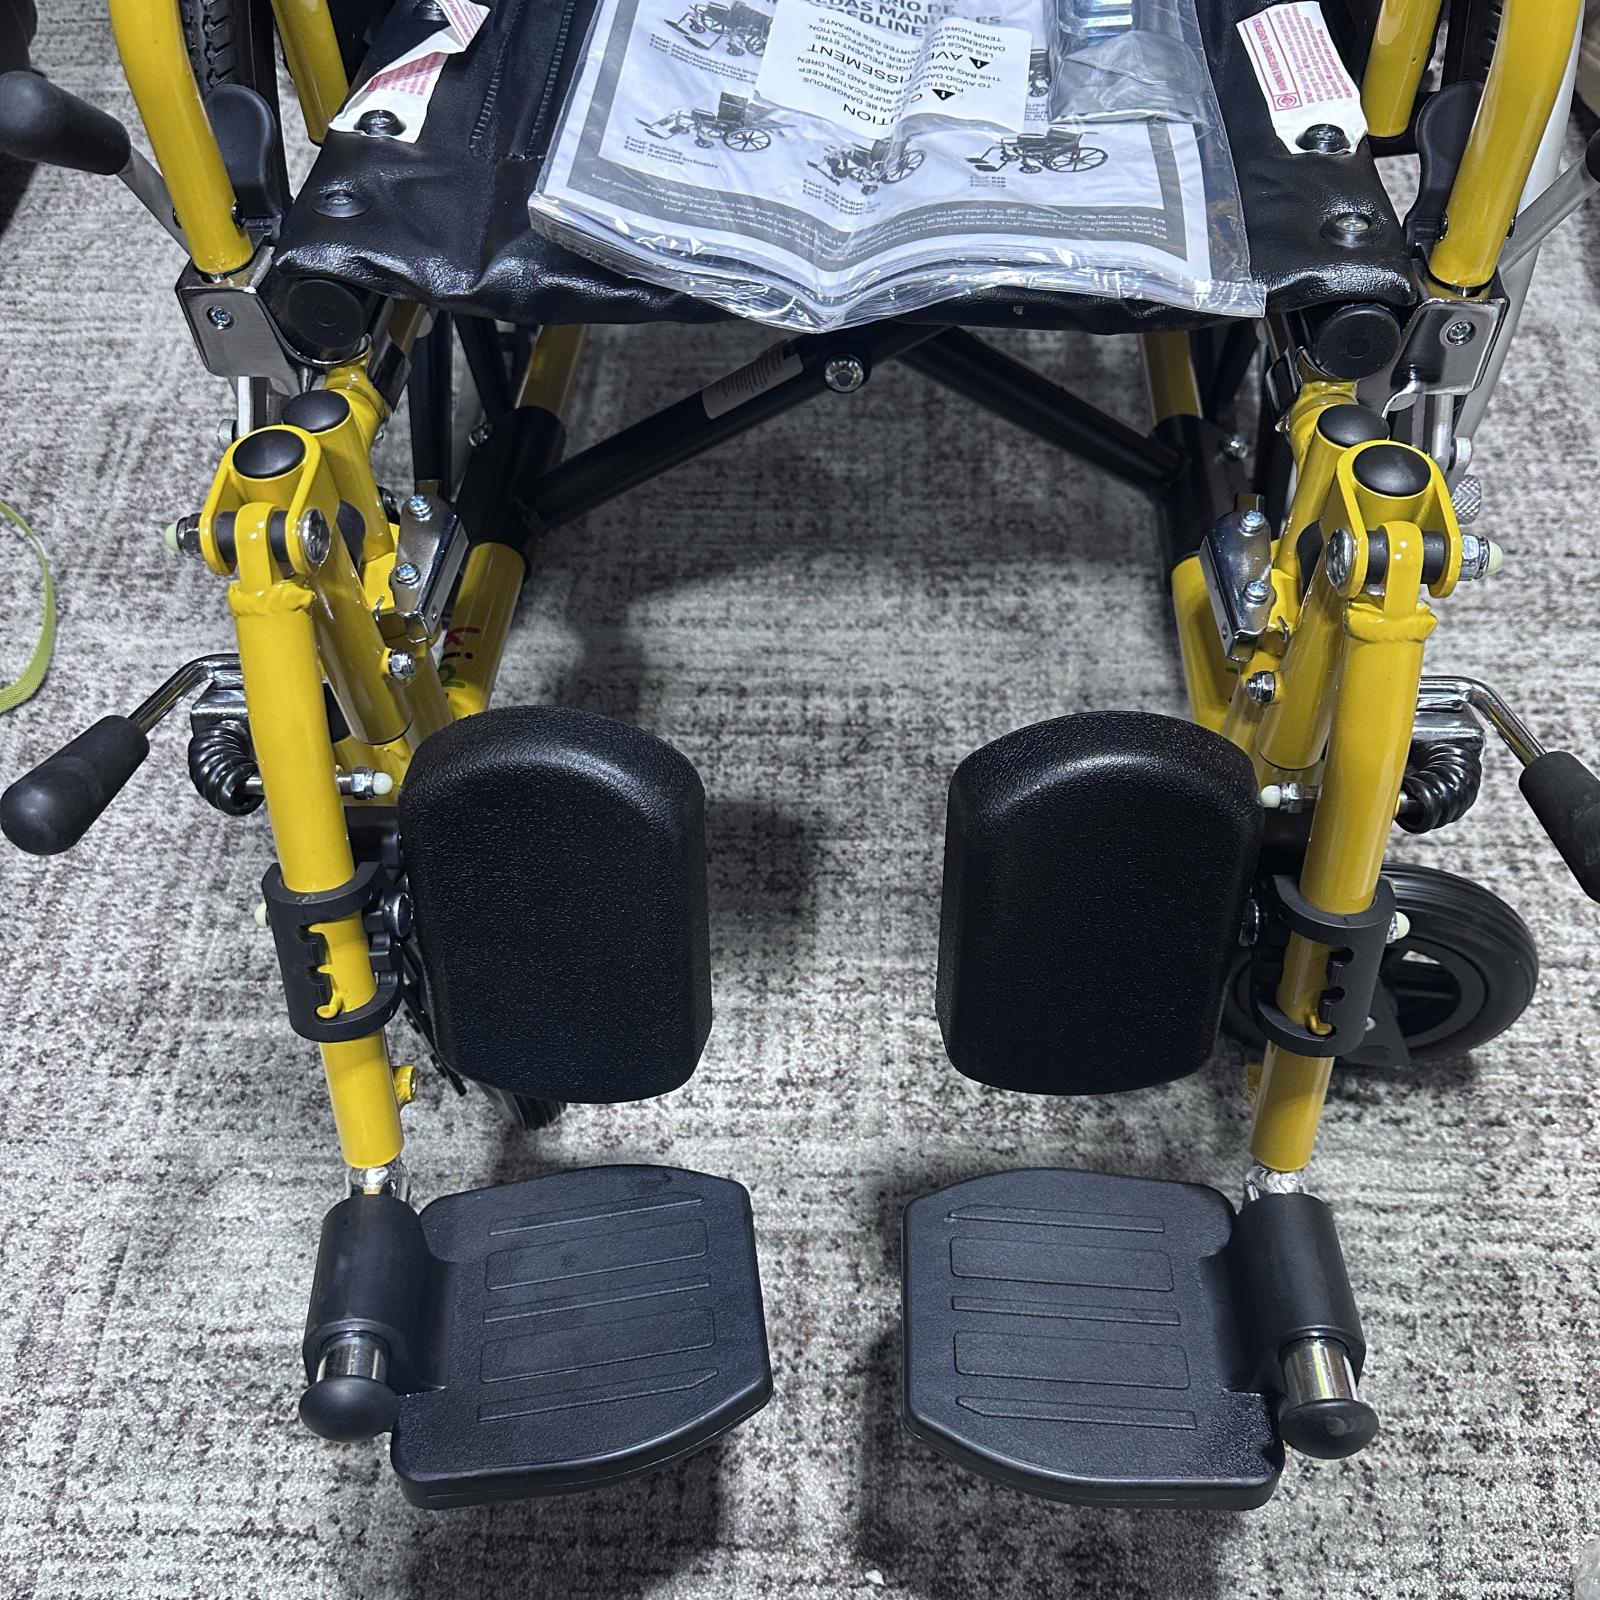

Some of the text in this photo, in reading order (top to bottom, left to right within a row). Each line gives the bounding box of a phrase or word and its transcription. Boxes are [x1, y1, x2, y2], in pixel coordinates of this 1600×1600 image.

[819, 17, 862, 37] ENFANTS
[815, 34, 840, 46] ETRE
[862, 34, 881, 46] DES
[842, 42, 884, 66] PEUVENT
[875, 49, 886, 58] LA
[797, 56, 846, 76] CHILDREN
[847, 73, 867, 86] AND
[945, 75, 976, 87] AVOID
[826, 74, 892, 104] SUFFOCATION
[923, 81, 964, 93] PLASTIC
